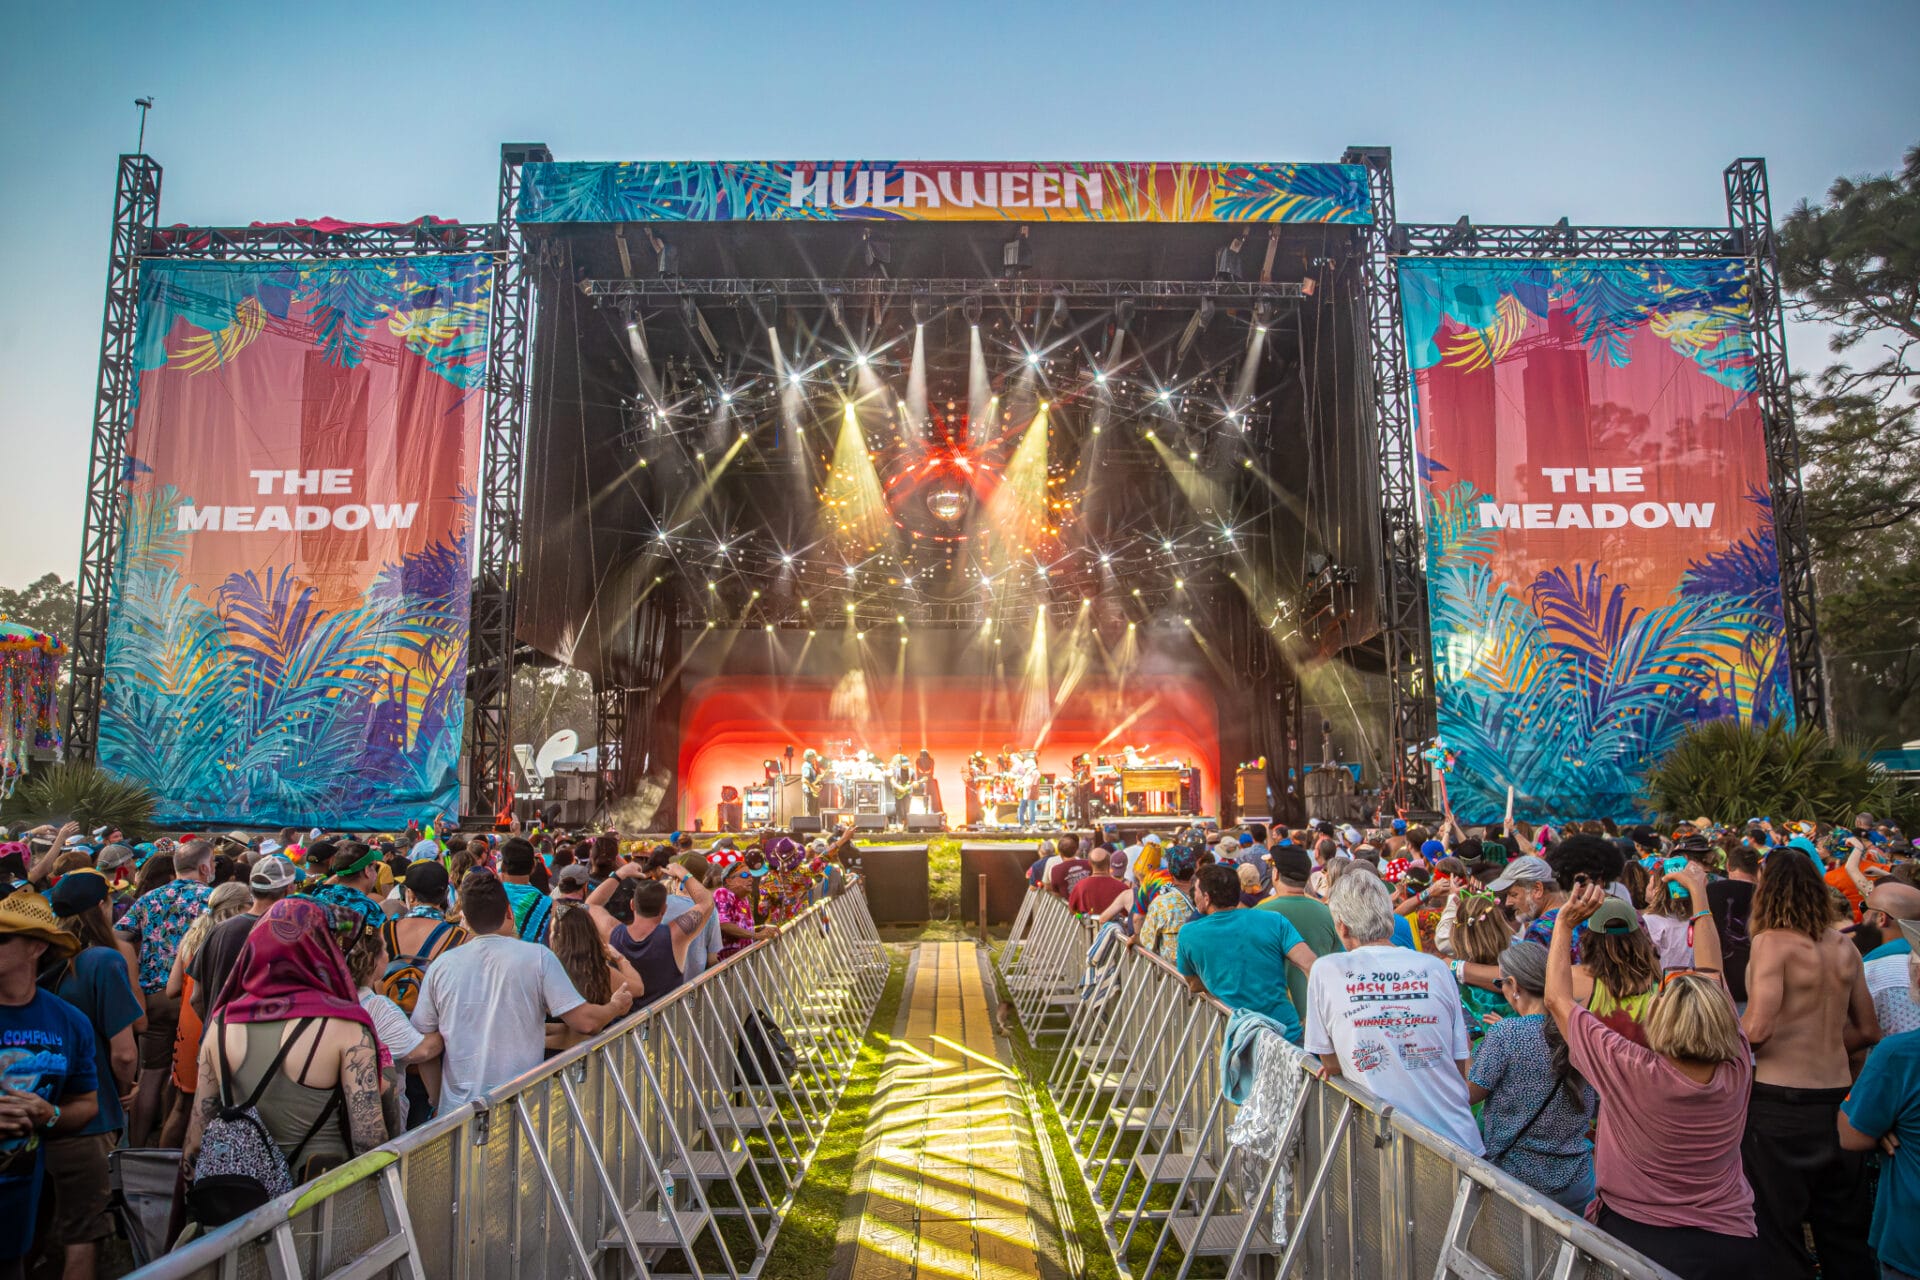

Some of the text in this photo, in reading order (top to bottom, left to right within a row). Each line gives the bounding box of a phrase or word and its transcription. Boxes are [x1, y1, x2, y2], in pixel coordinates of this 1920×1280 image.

[790, 171, 1103, 209] HULAWEEN
[249, 468, 354, 495] THE
[1541, 467, 1645, 492] THE
[177, 502, 419, 531] MEADOW
[1479, 502, 1716, 529] MEADOW
[1346, 981, 1429, 994] HASH BASH
[1371, 972, 1400, 982] 2000
[1350, 993, 1429, 1002] BENEFIT
[1354, 1016, 1438, 1027] WINNER'S CIRCLE
[3, 1029, 63, 1046] COMPANY
